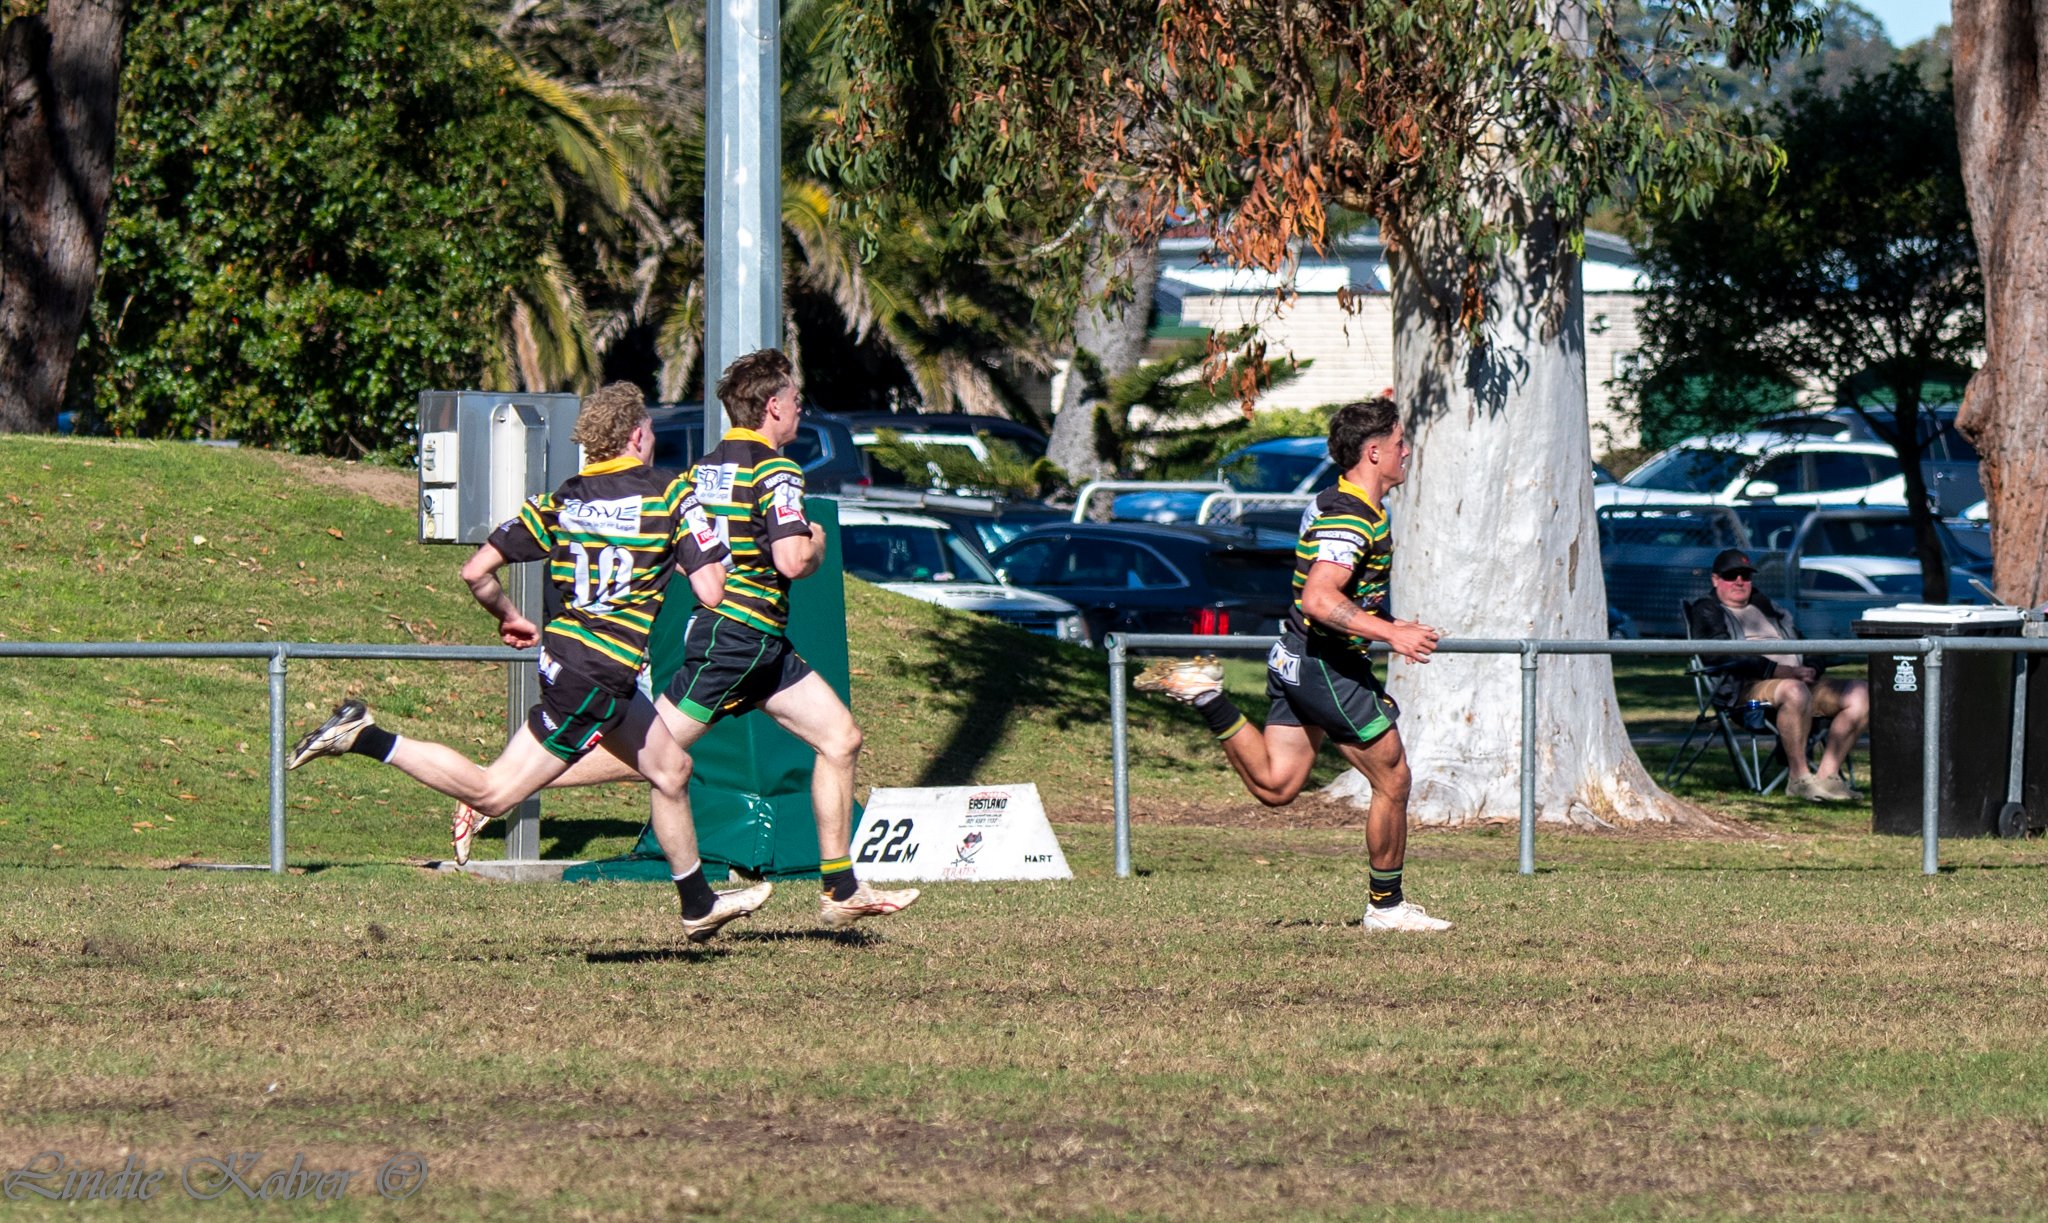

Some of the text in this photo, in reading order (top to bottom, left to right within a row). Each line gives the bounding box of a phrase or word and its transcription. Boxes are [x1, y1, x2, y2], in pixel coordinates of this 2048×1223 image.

[569, 541, 634, 608] 10
[968, 798, 1008, 810] EASTLAND
[1024, 854, 1053, 864] HART
